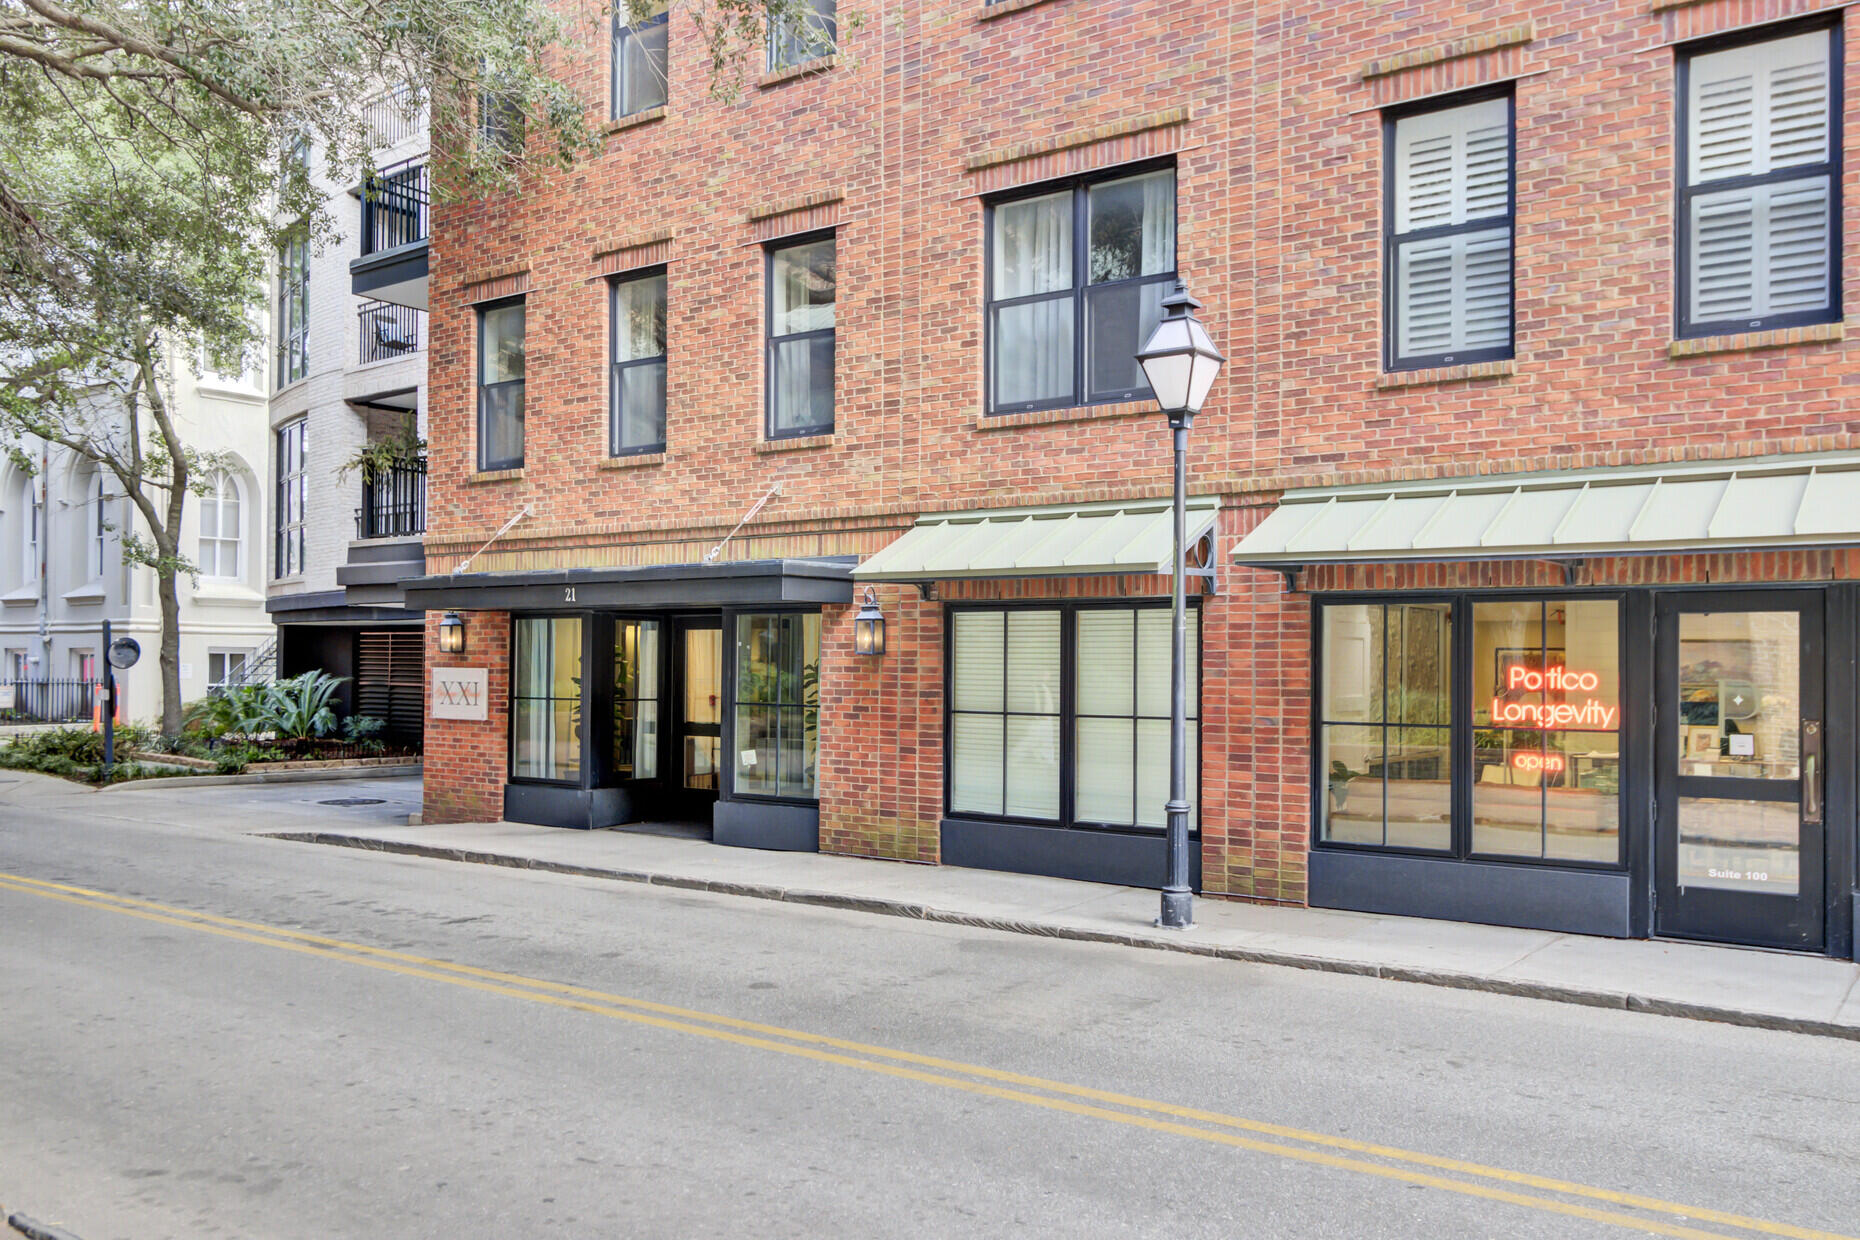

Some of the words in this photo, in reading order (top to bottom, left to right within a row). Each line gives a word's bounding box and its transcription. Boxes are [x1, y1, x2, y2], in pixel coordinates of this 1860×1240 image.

[565, 587, 576, 602] 21
[440, 680, 480, 706] XXI
[1493, 698, 1616, 729] Longevity
[1708, 869, 1742, 880] Suite
[1745, 871, 1768, 881] 100
